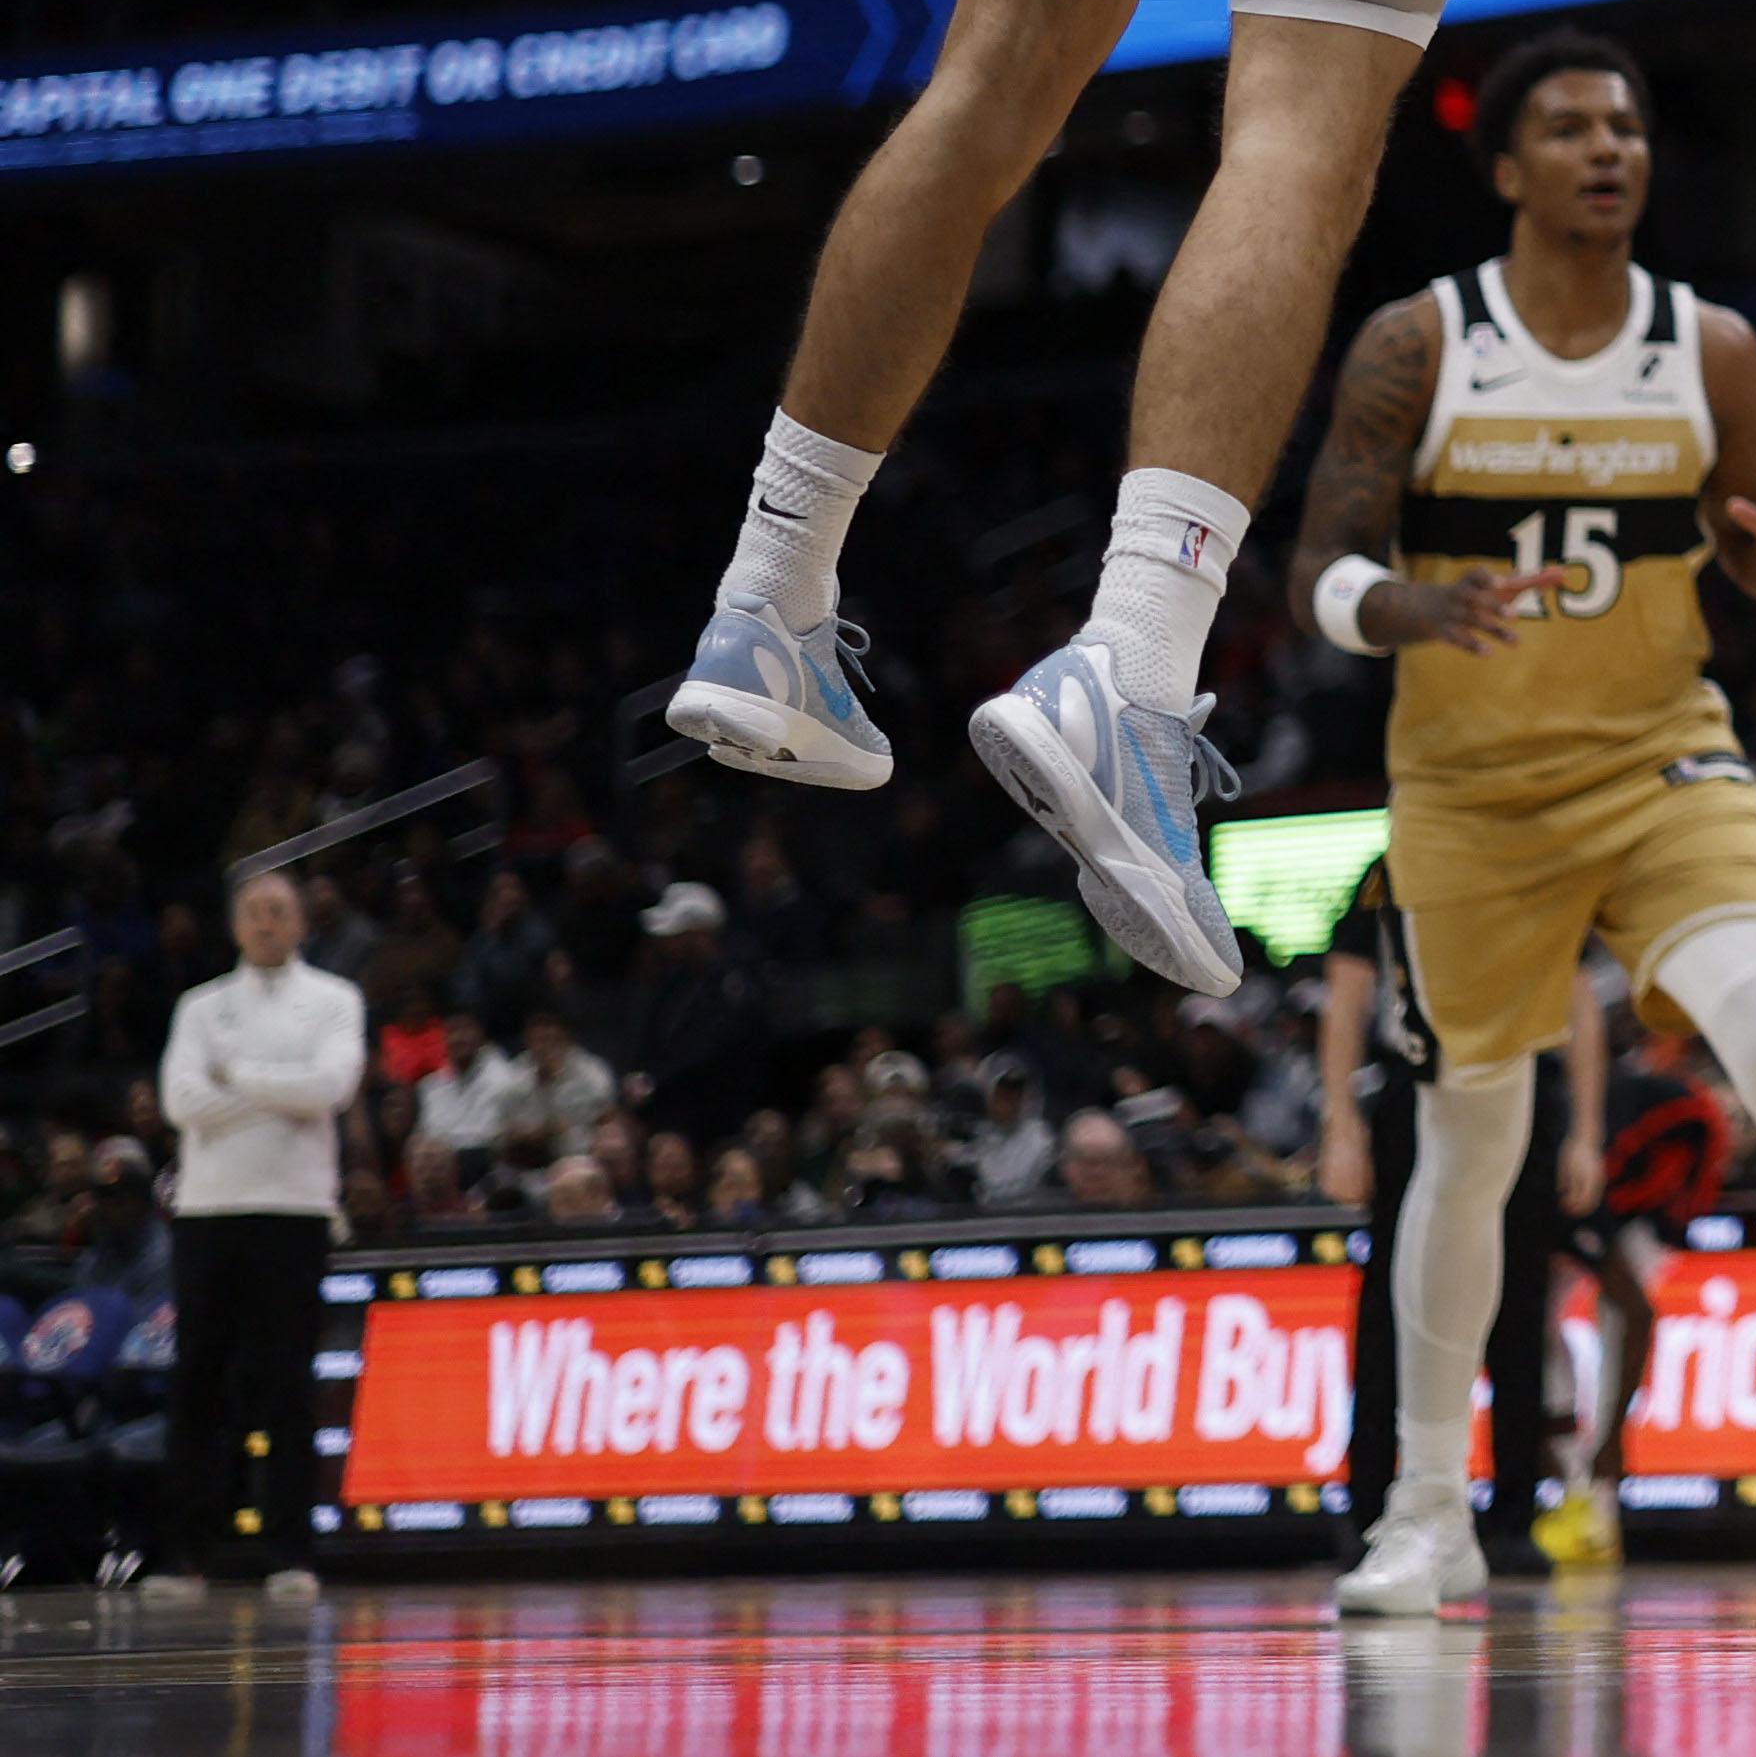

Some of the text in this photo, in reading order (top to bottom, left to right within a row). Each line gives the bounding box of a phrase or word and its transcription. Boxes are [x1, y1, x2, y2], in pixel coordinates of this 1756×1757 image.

[1508, 507, 1623, 619] 15
[488, 1316, 750, 1458] Where
[764, 1308, 909, 1451] the
[930, 1295, 1188, 1447] World
[1195, 1293, 1357, 1476] Buy
